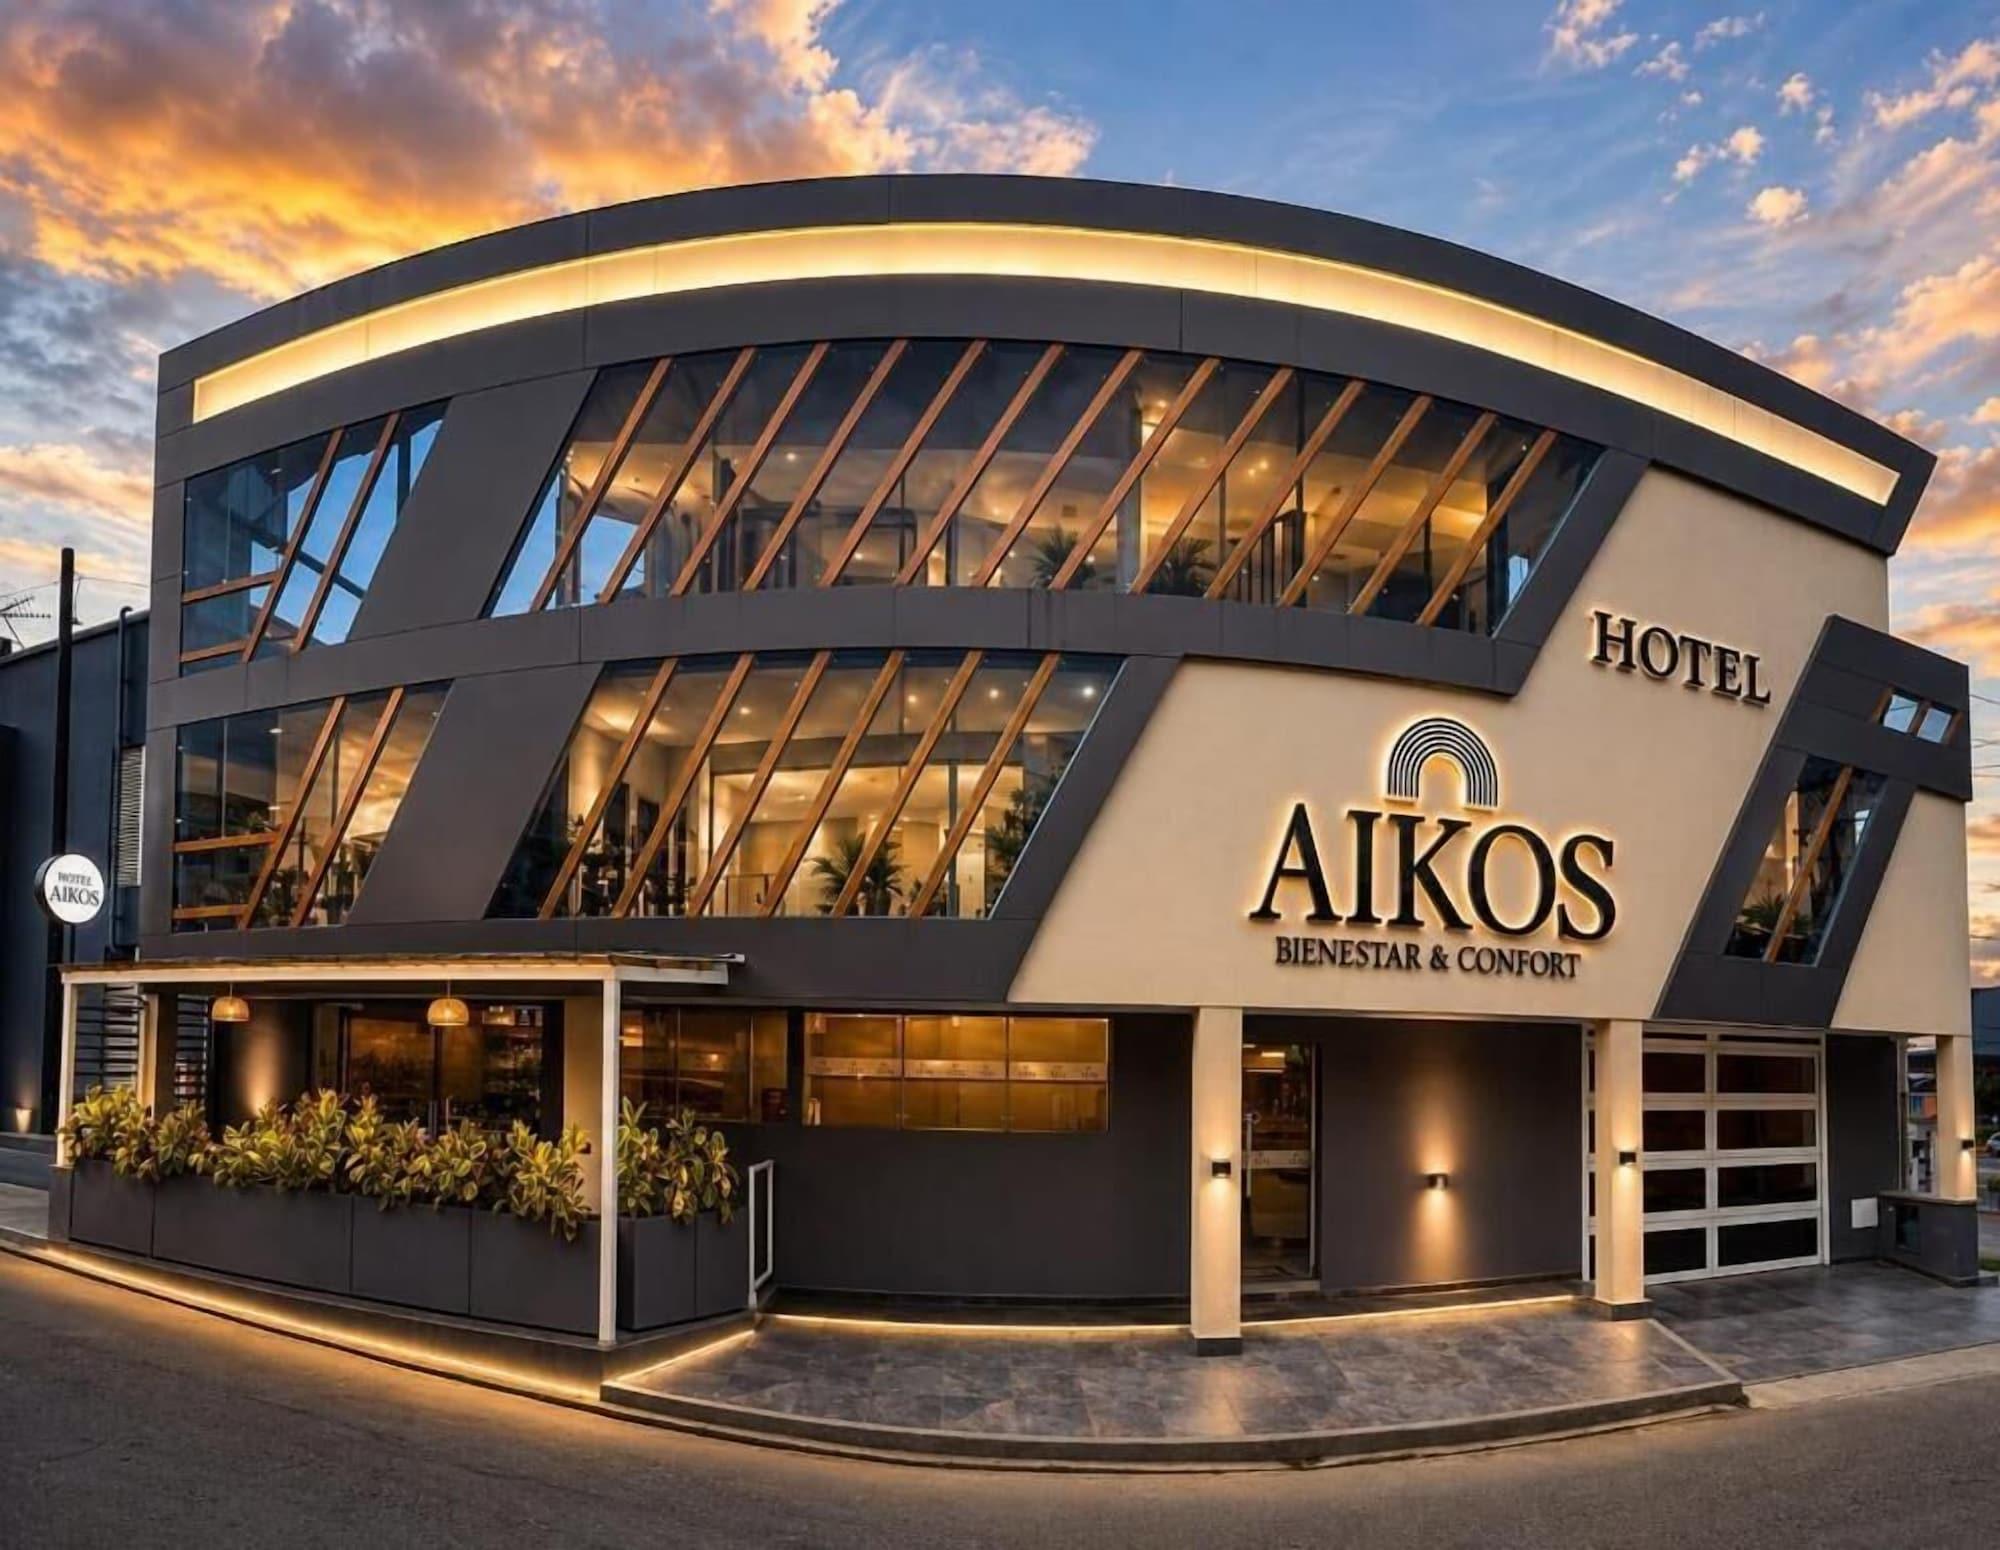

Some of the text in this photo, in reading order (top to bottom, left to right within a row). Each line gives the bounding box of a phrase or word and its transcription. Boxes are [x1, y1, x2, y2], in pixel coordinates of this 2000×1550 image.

[1591, 610, 1772, 705] HOTEL
[49, 885, 100, 907] AIKOS
[1249, 802, 1617, 941] AIKOS
[1275, 935, 1582, 980] BIENESTAR & CONFORT
